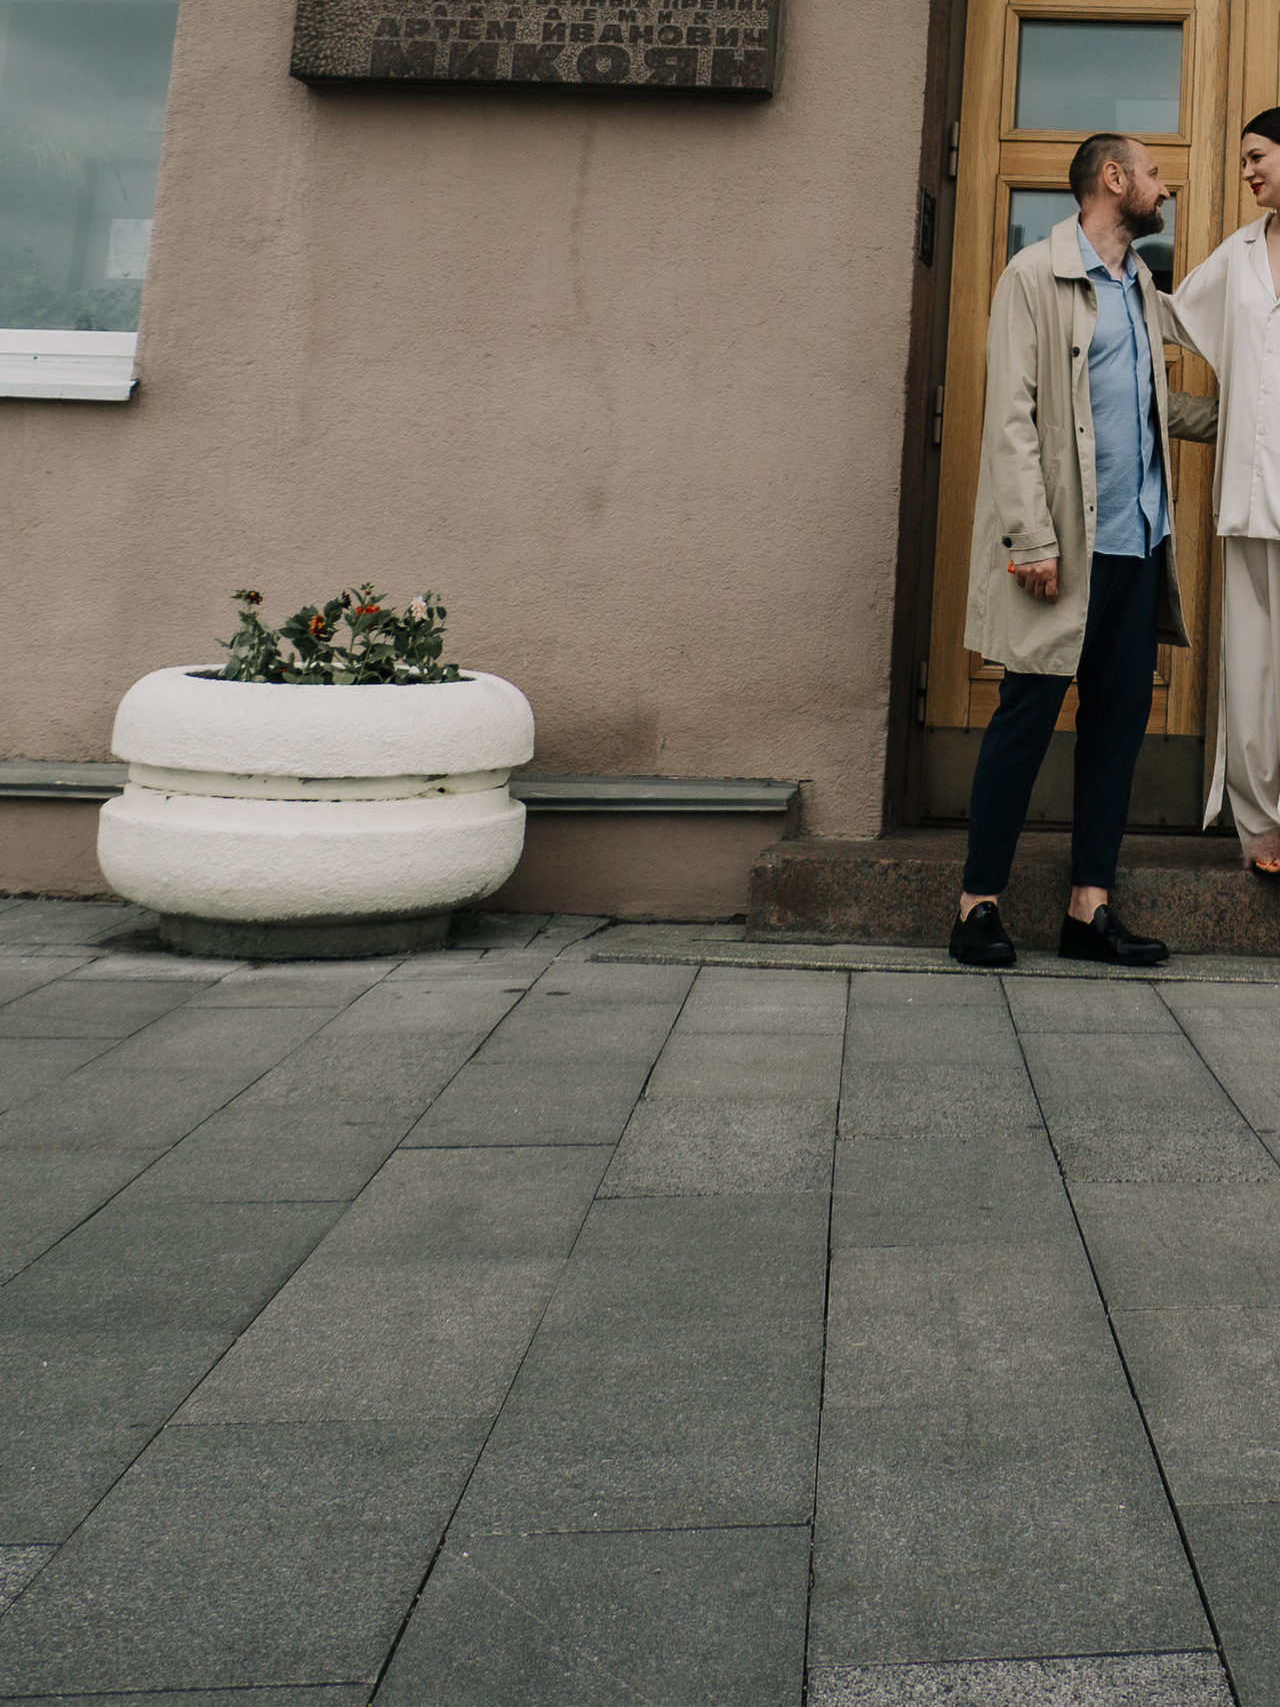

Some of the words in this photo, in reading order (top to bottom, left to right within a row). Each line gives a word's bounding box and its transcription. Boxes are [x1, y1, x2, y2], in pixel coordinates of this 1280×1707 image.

[374, 17, 517, 41] АРТЕМ
[542, 21, 768, 46] ИВАНОВИЧ
[370, 40, 767, 87] МИКОЯН
